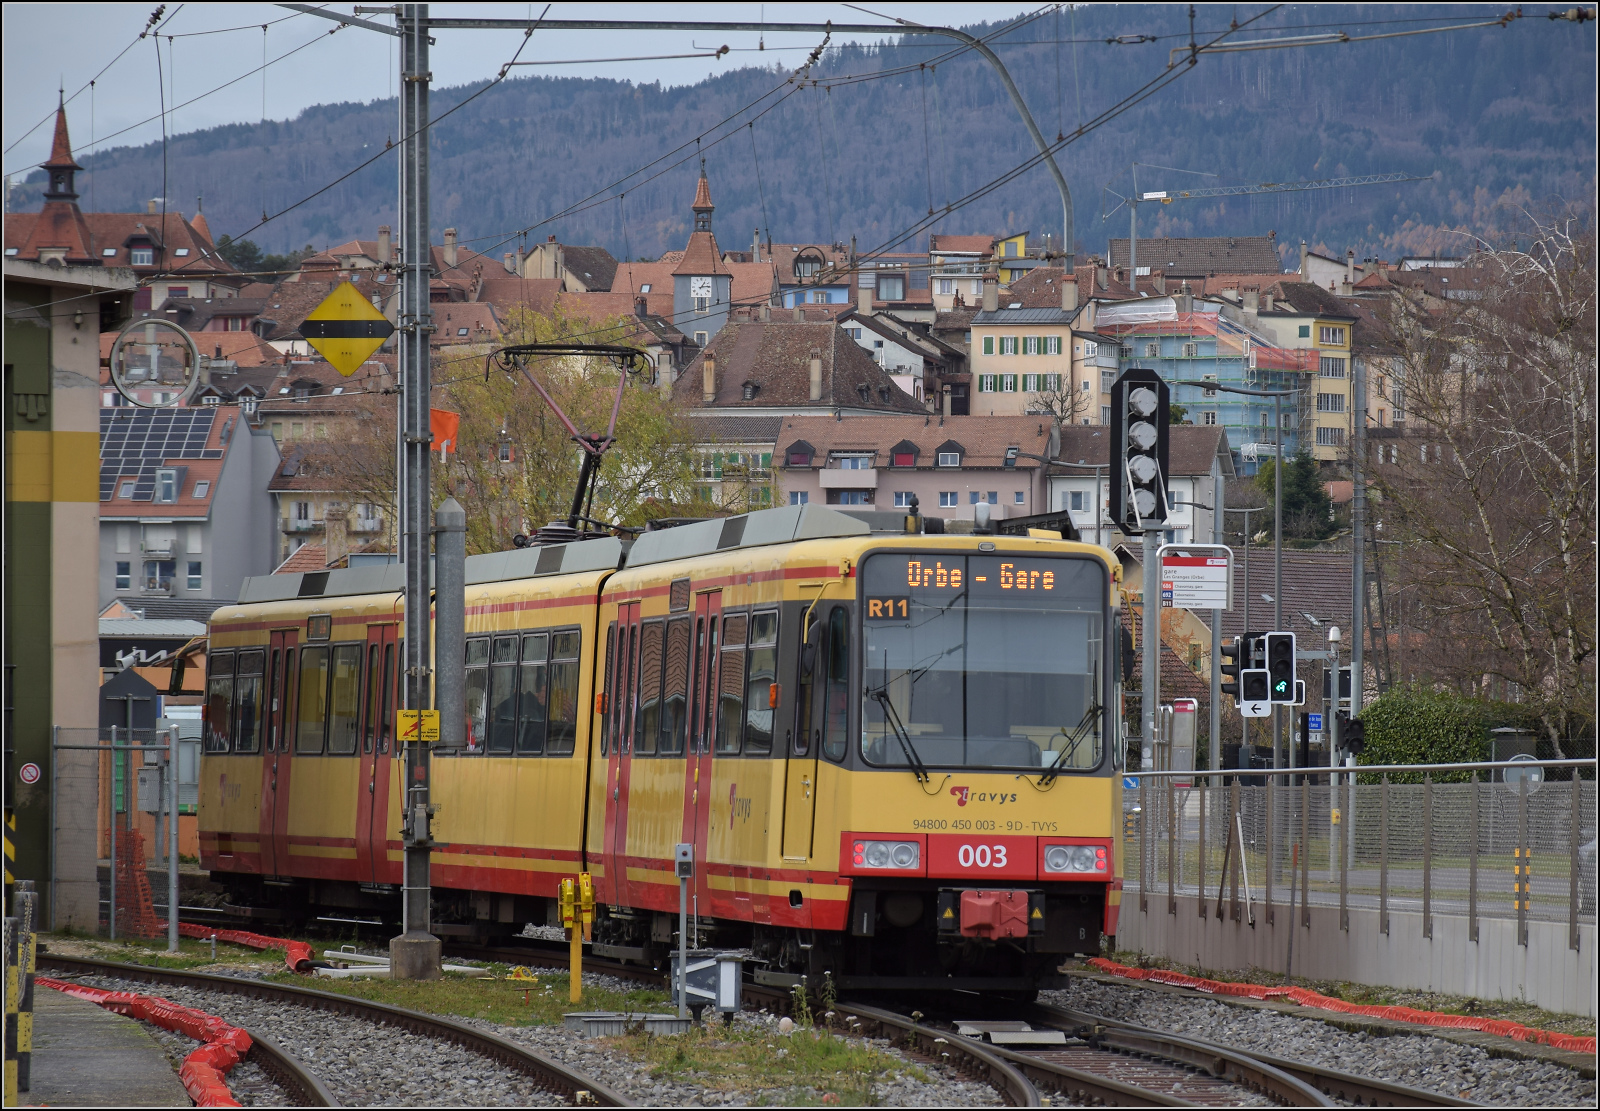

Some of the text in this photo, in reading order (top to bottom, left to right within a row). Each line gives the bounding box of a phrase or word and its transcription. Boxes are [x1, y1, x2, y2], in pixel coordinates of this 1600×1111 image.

[908, 561, 962, 587] Orbe
[1000, 563, 1054, 590] Gare
[868, 599, 908, 617] R11
[959, 787, 1017, 805] travys
[913, 819, 947, 830] 94800
[951, 819, 972, 830] 450
[975, 820, 995, 831] 003
[1031, 821, 1058, 832] TVYS
[958, 844, 1007, 868] 003
